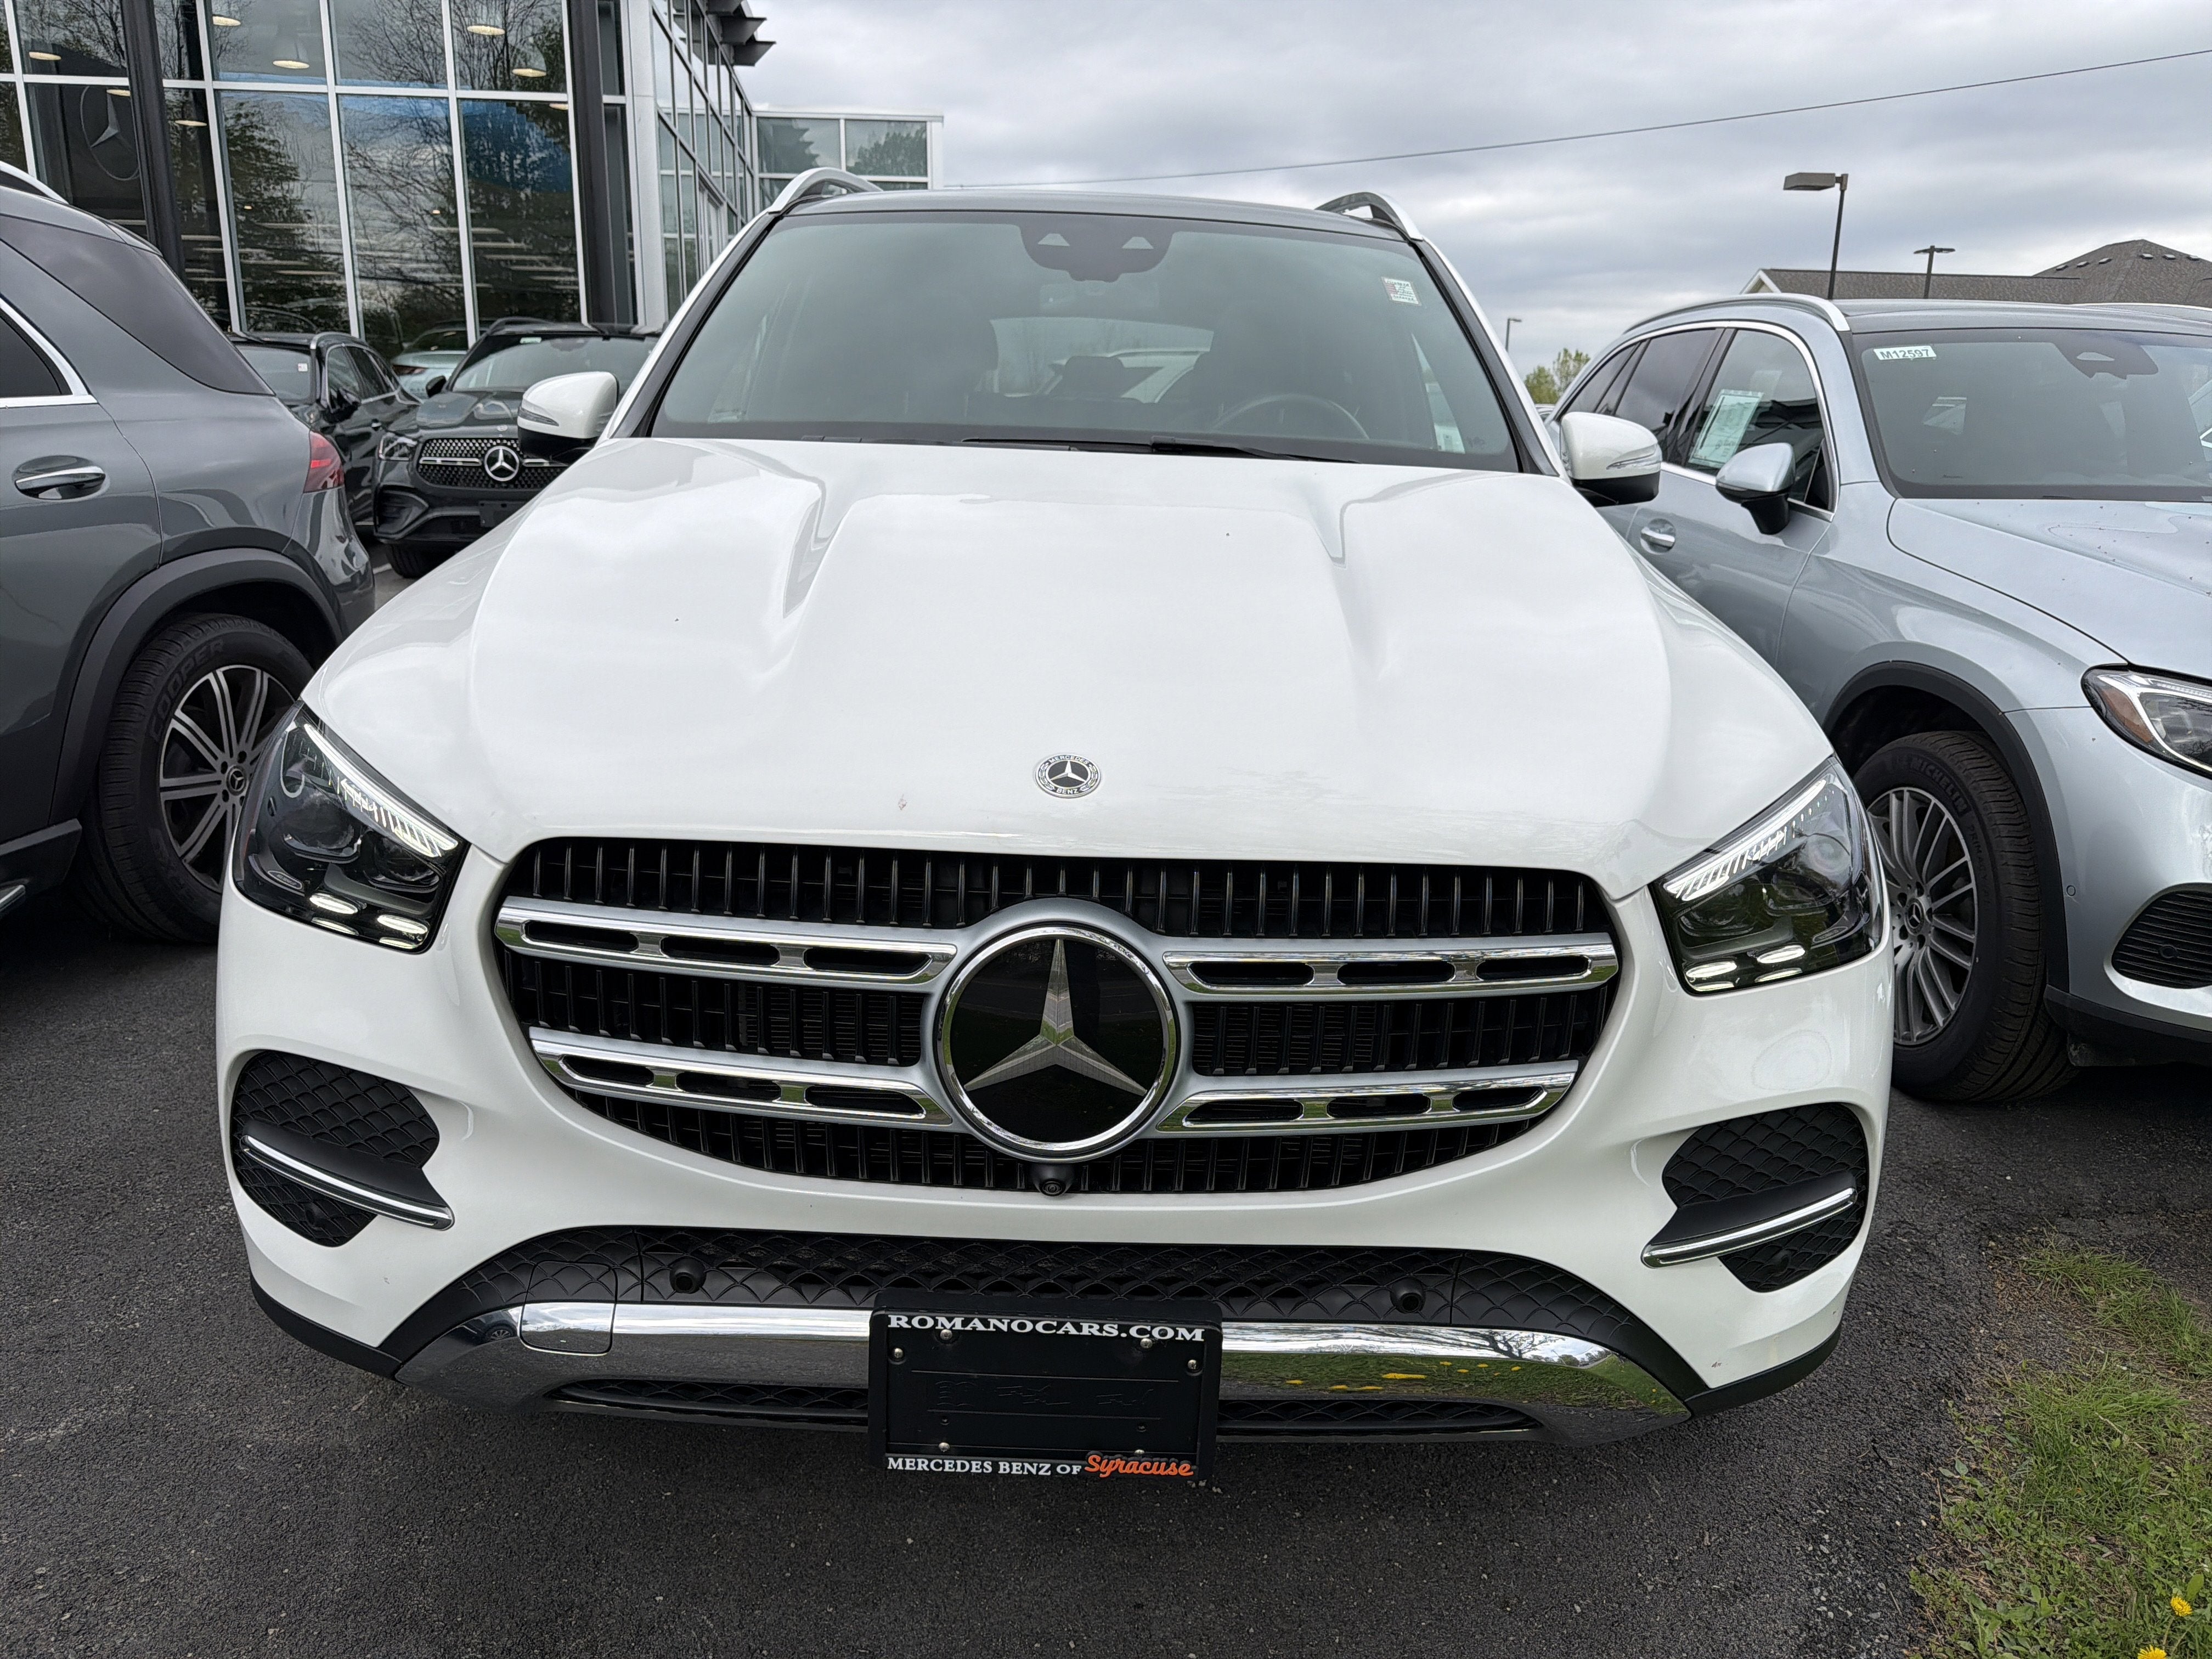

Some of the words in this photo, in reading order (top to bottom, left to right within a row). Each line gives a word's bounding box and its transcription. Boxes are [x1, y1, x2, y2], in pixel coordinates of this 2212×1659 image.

[1880, 349, 1929, 359] M12597
[149, 639, 224, 741] COOPER
[1048, 755, 1090, 765] MERCEDES
[1910, 757, 1968, 812] MICHELIN
[888, 1314, 1205, 1341] ROMANOCARS.COM
[888, 1457, 992, 1474] MERCEDES
[998, 1462, 1051, 1476] BENZ
[1056, 1464, 1082, 1475] OF
[1084, 1454, 1194, 1478] Syracuse
